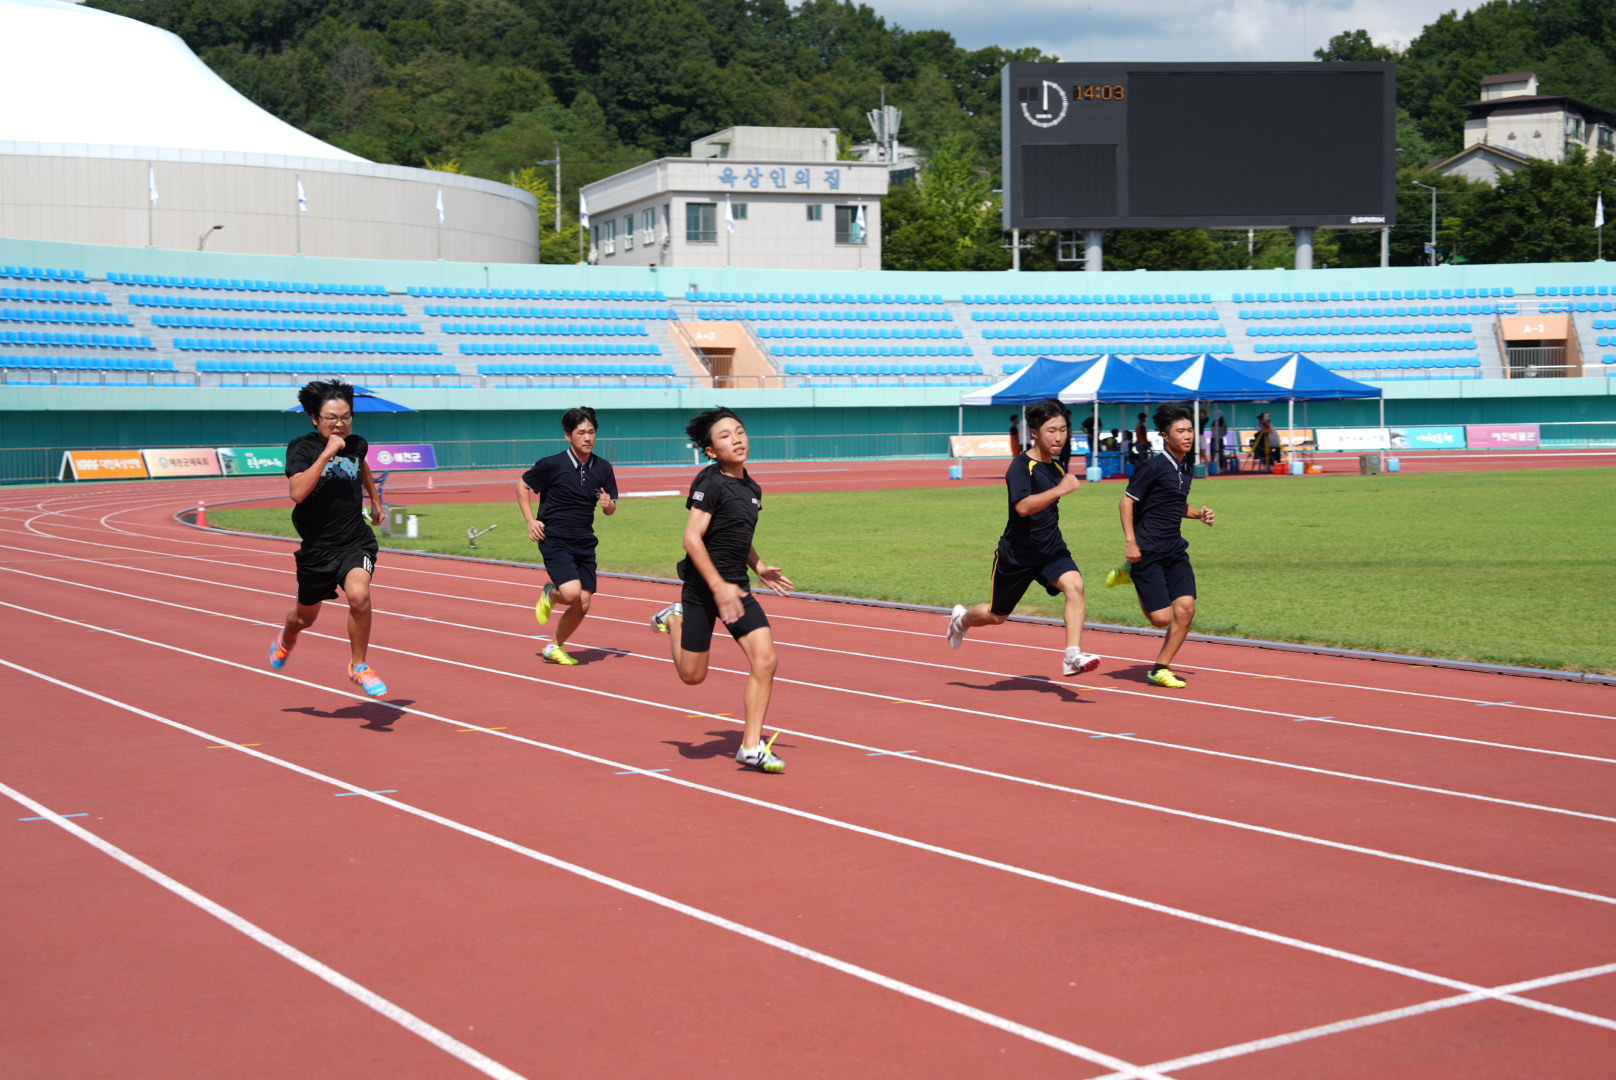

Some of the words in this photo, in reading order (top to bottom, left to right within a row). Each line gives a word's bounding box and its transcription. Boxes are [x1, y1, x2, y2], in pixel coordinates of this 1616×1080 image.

[1076, 85, 1125, 100] 14:03
[719, 167, 811, 190] 육상인의
[823, 168, 841, 190] 집
[1524, 325, 1544, 333] A-3
[696, 332, 715, 340] A-2
[168, 457, 210, 467] 예천군체육회
[393, 452, 422, 462] 예천군
